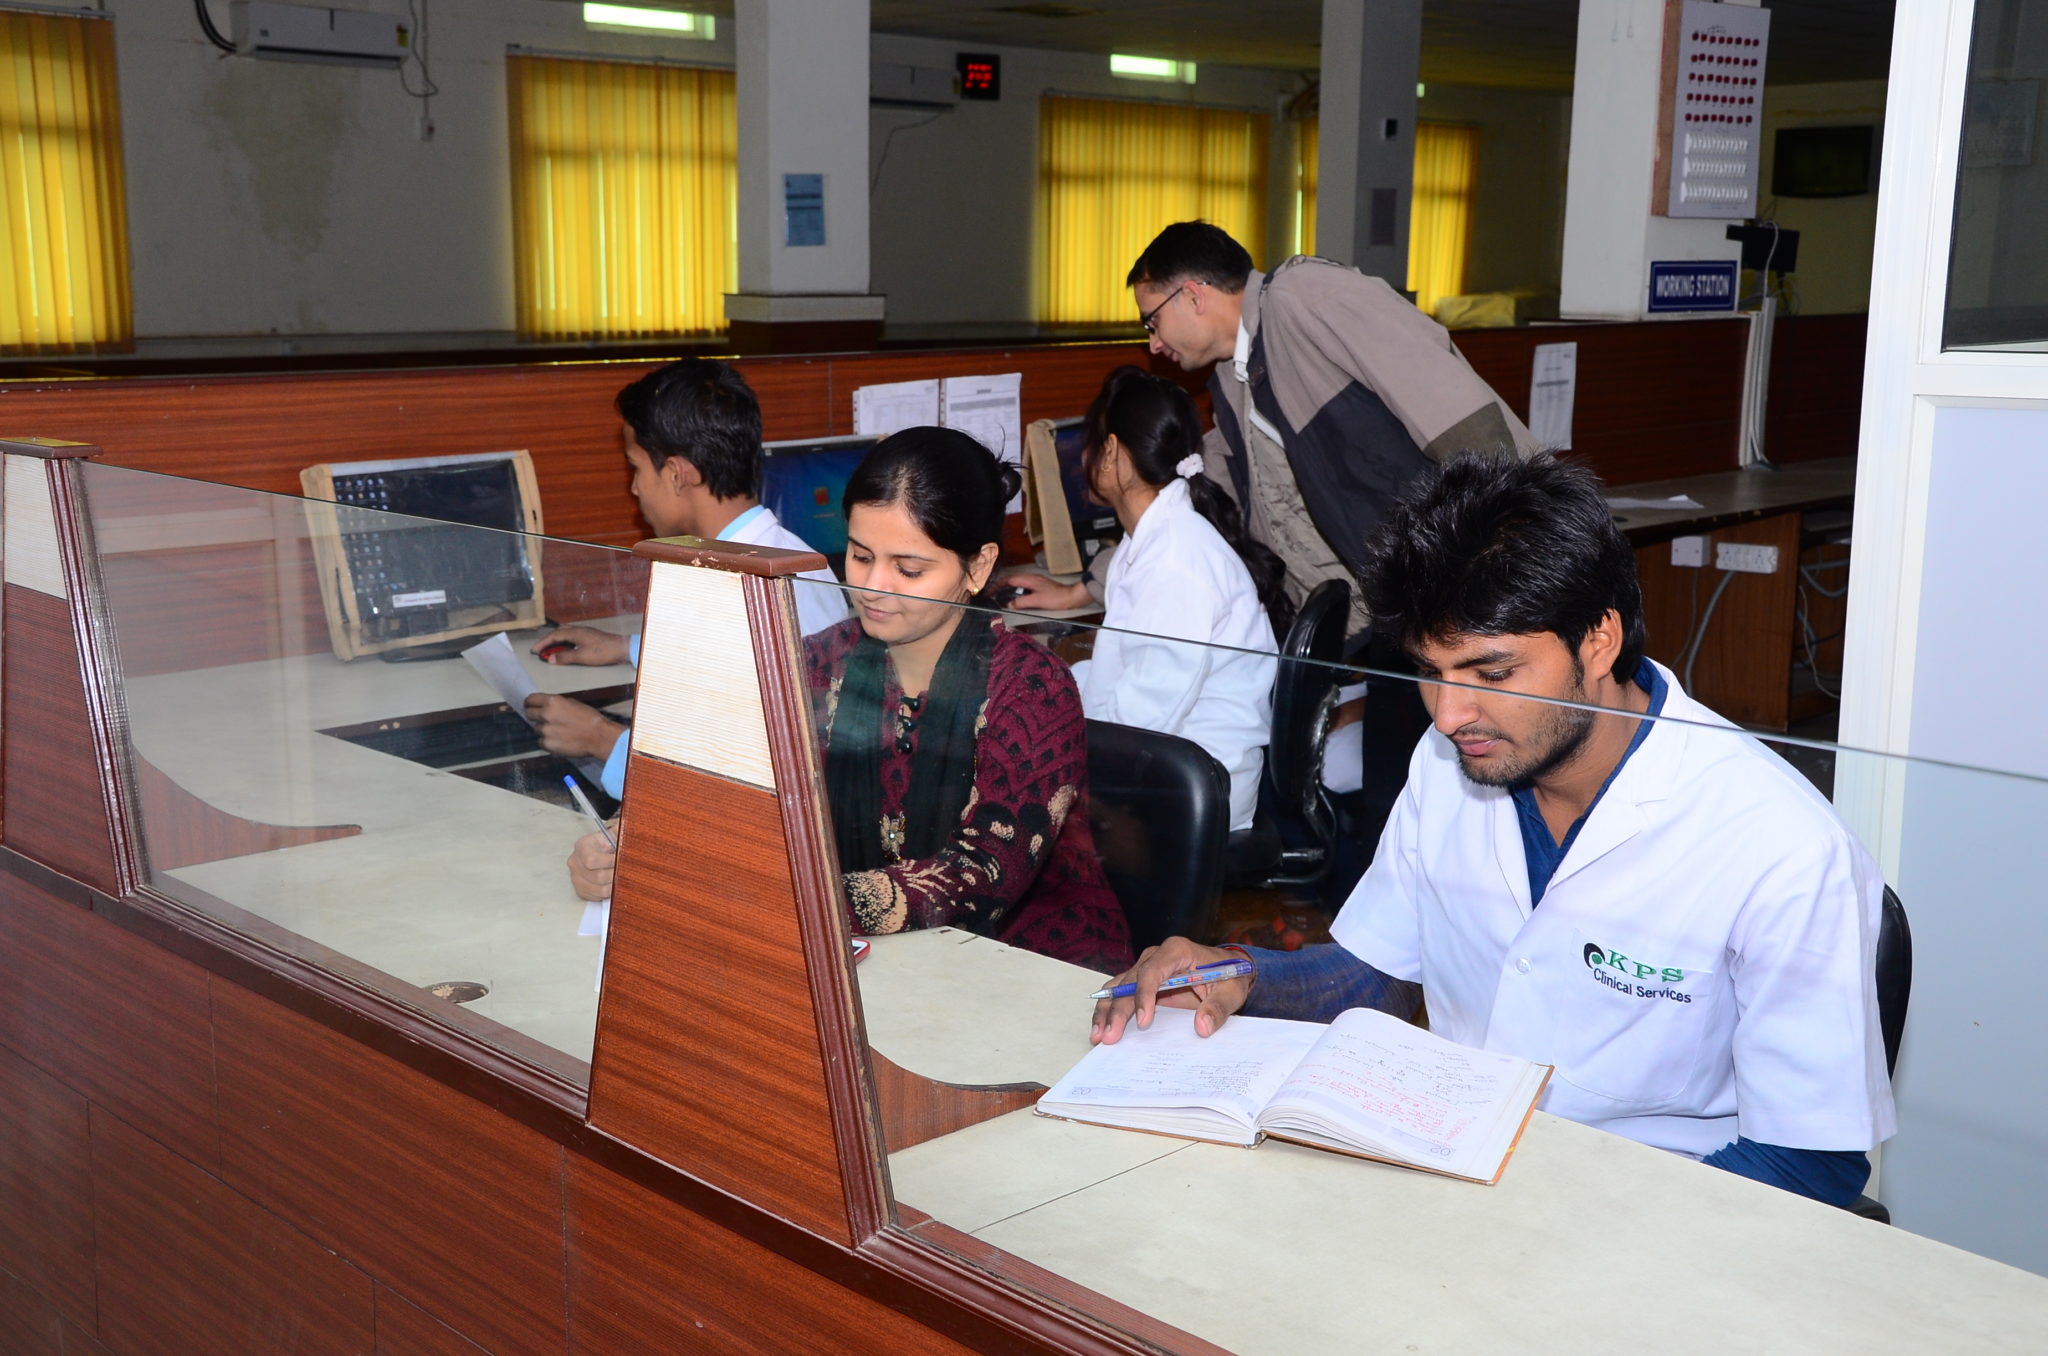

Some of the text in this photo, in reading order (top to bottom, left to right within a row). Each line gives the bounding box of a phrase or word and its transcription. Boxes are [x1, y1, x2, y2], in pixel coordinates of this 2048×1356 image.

[1656, 274, 1730, 297] WORKING STATION
[1593, 967, 1692, 1003] Clinical Services
[1430, 1145, 1451, 1157] 02
